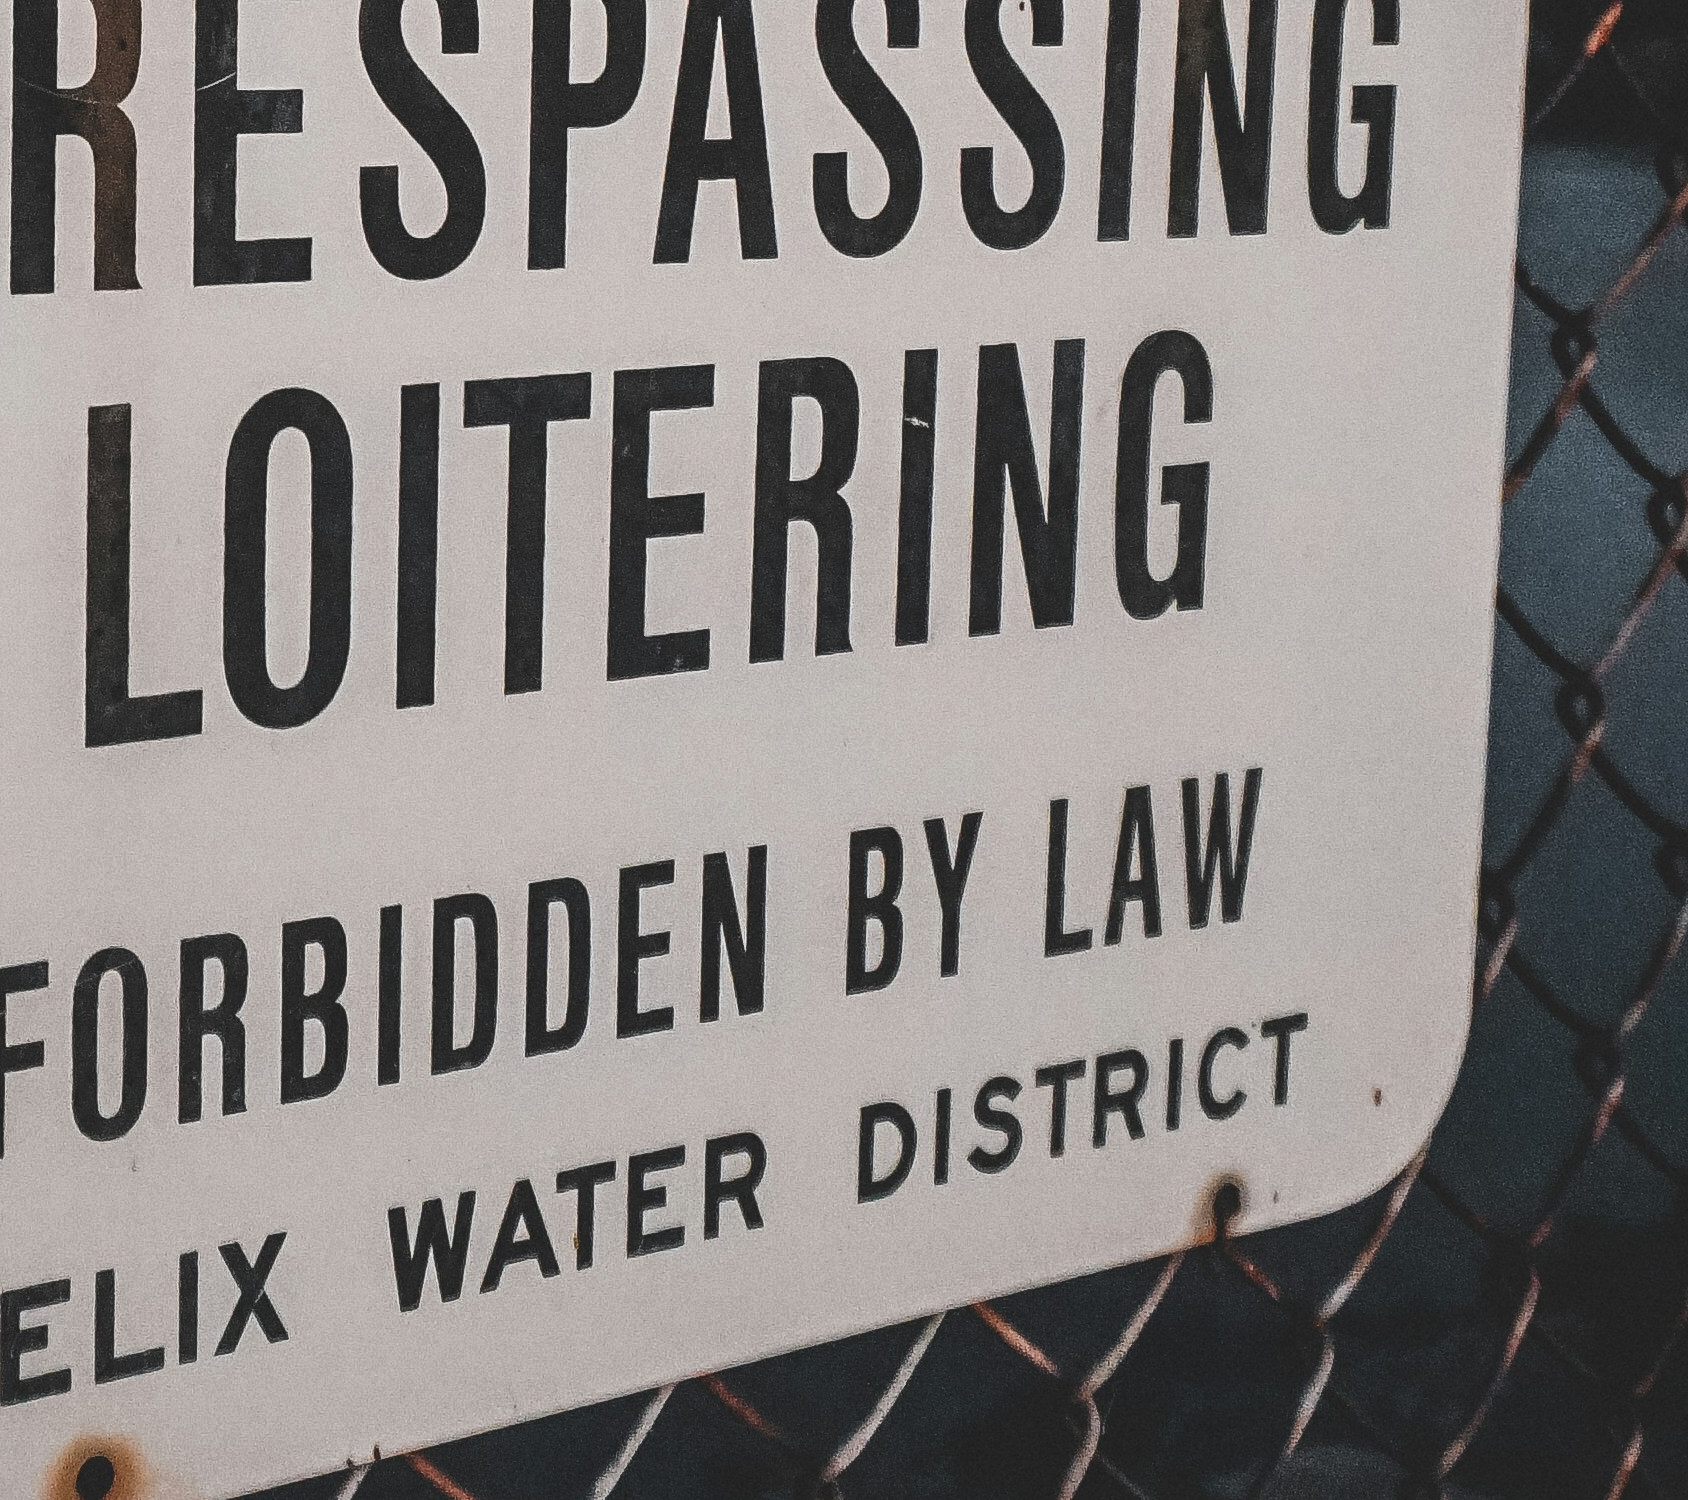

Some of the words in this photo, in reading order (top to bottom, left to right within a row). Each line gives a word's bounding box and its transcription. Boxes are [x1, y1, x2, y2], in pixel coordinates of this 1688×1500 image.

[86, 330, 1212, 747] LOITERING
[846, 813, 982, 994] BY
[1045, 768, 1261, 956] LAW
[388, 1132, 766, 1311] WATER
[858, 1013, 1307, 1202] DISTRICT
